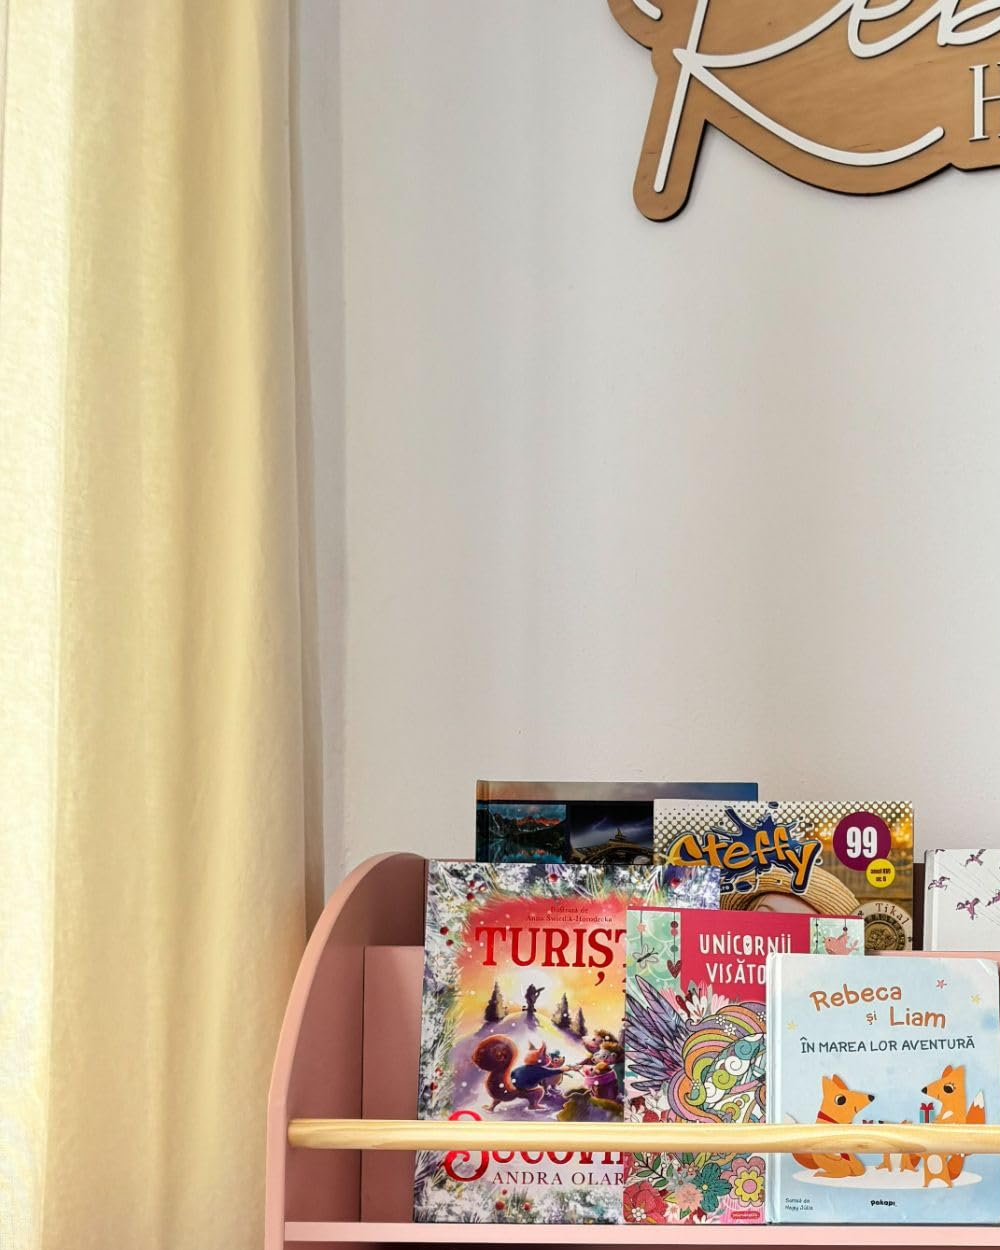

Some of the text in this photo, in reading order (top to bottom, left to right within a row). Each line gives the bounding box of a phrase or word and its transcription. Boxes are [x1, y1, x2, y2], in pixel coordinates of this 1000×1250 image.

[846, 826, 878, 859] 99
[875, 902, 910, 925] Tikal
[705, 958, 766, 985] VISĂTO
[808, 984, 902, 1012] Rebeca
[889, 1006, 946, 1029] Liam
[800, 1035, 976, 1054] ÎN MAREA LOR AVENTURĂ
[492, 1171, 624, 1186] ANDRA OLAR
